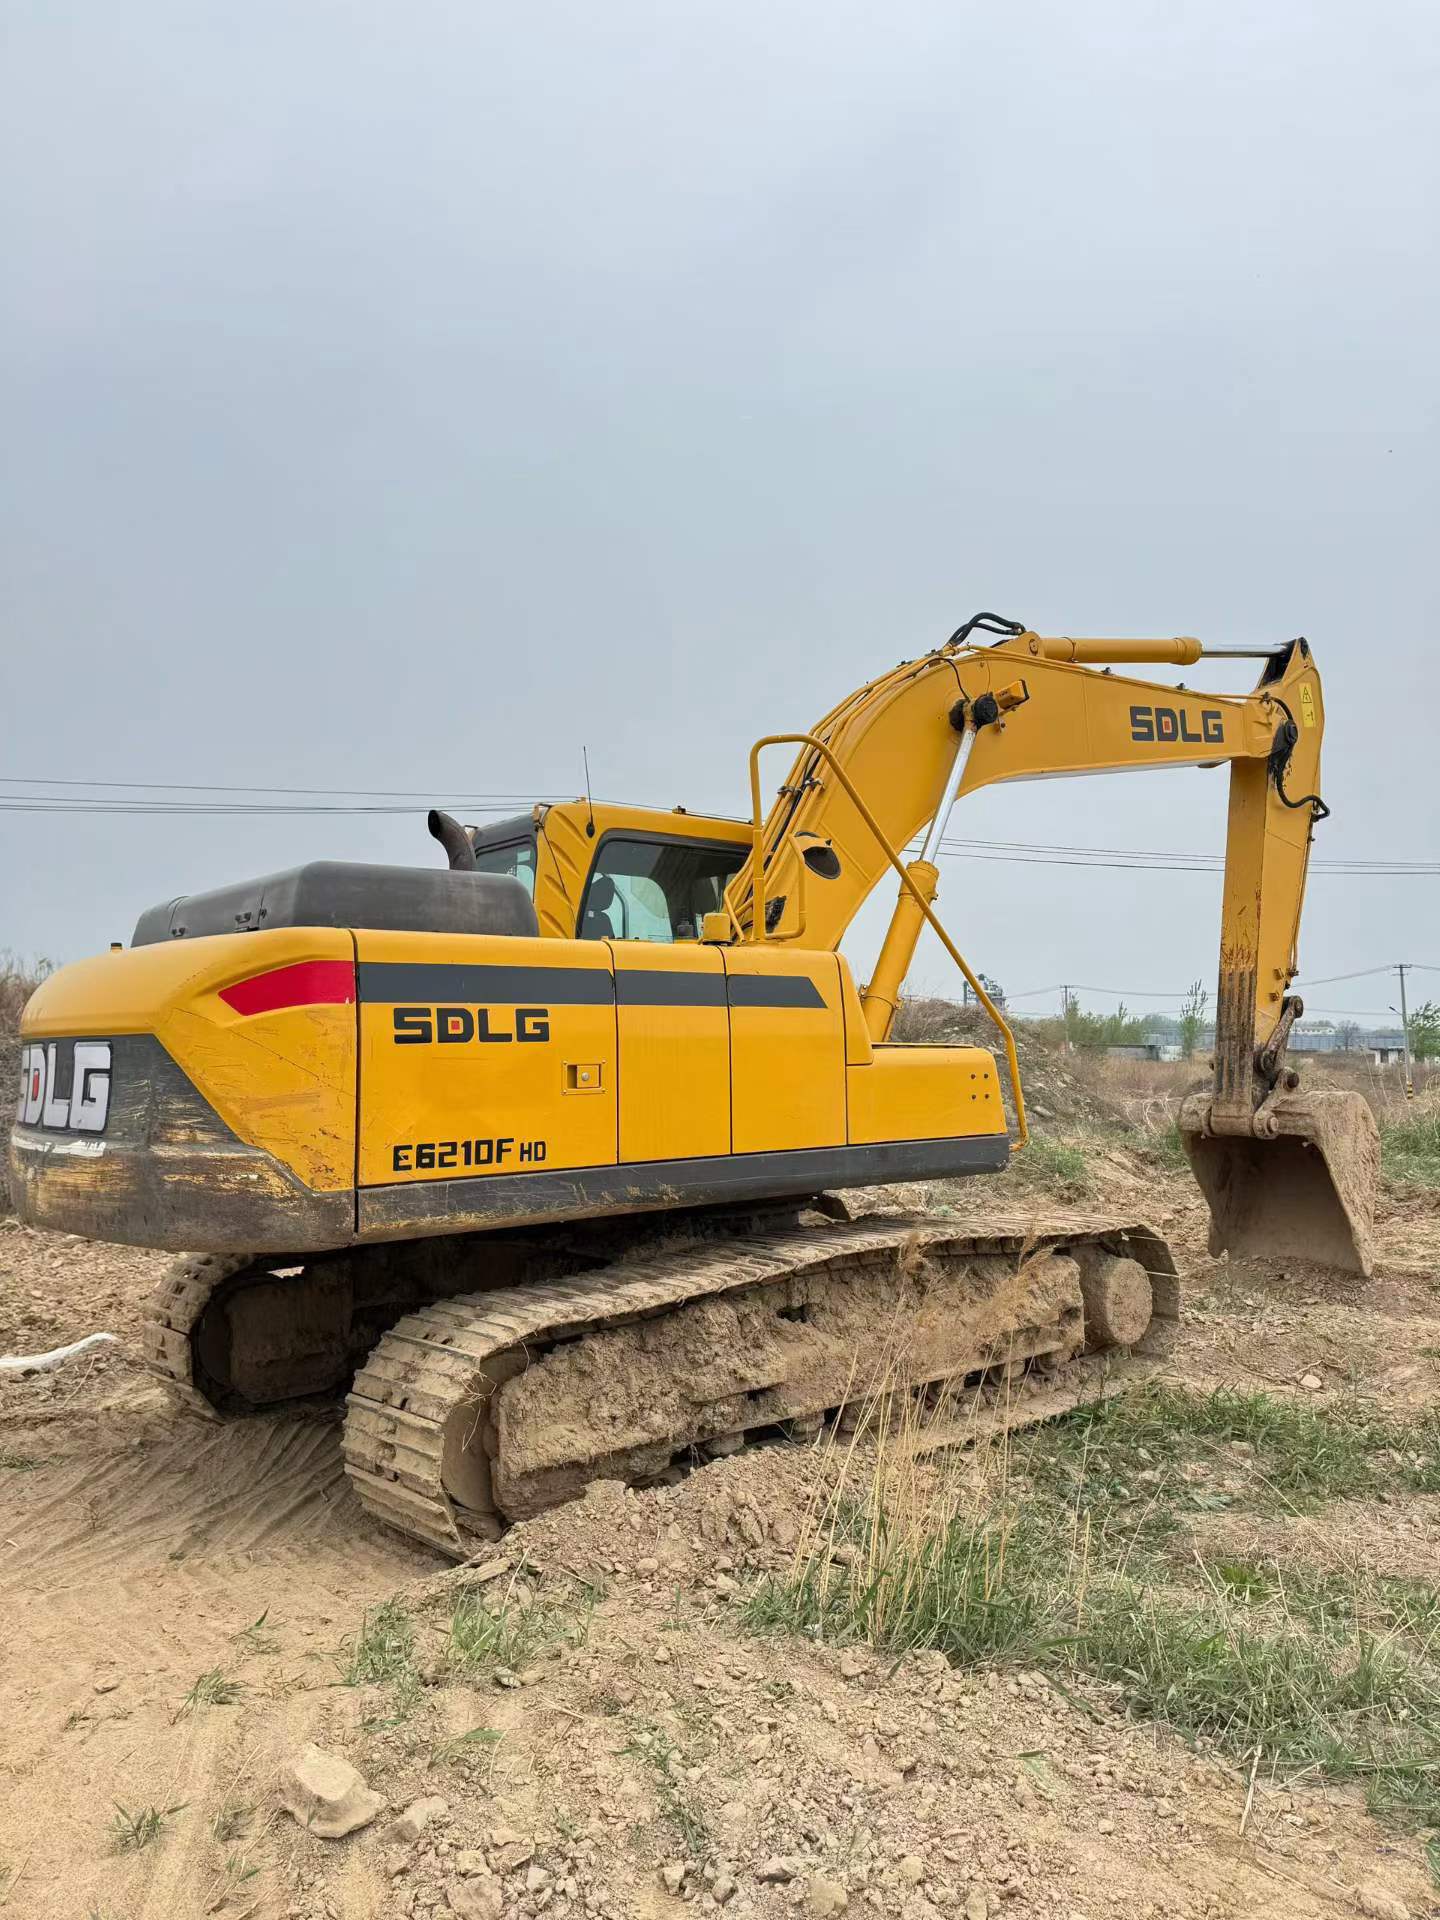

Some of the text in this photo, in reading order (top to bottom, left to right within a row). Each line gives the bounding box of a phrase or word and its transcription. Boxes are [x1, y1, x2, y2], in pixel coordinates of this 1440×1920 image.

[1129, 706, 1225, 743] SDLG
[393, 1007, 549, 1044] SDLG
[393, 1138, 546, 1171] E6210F HD
